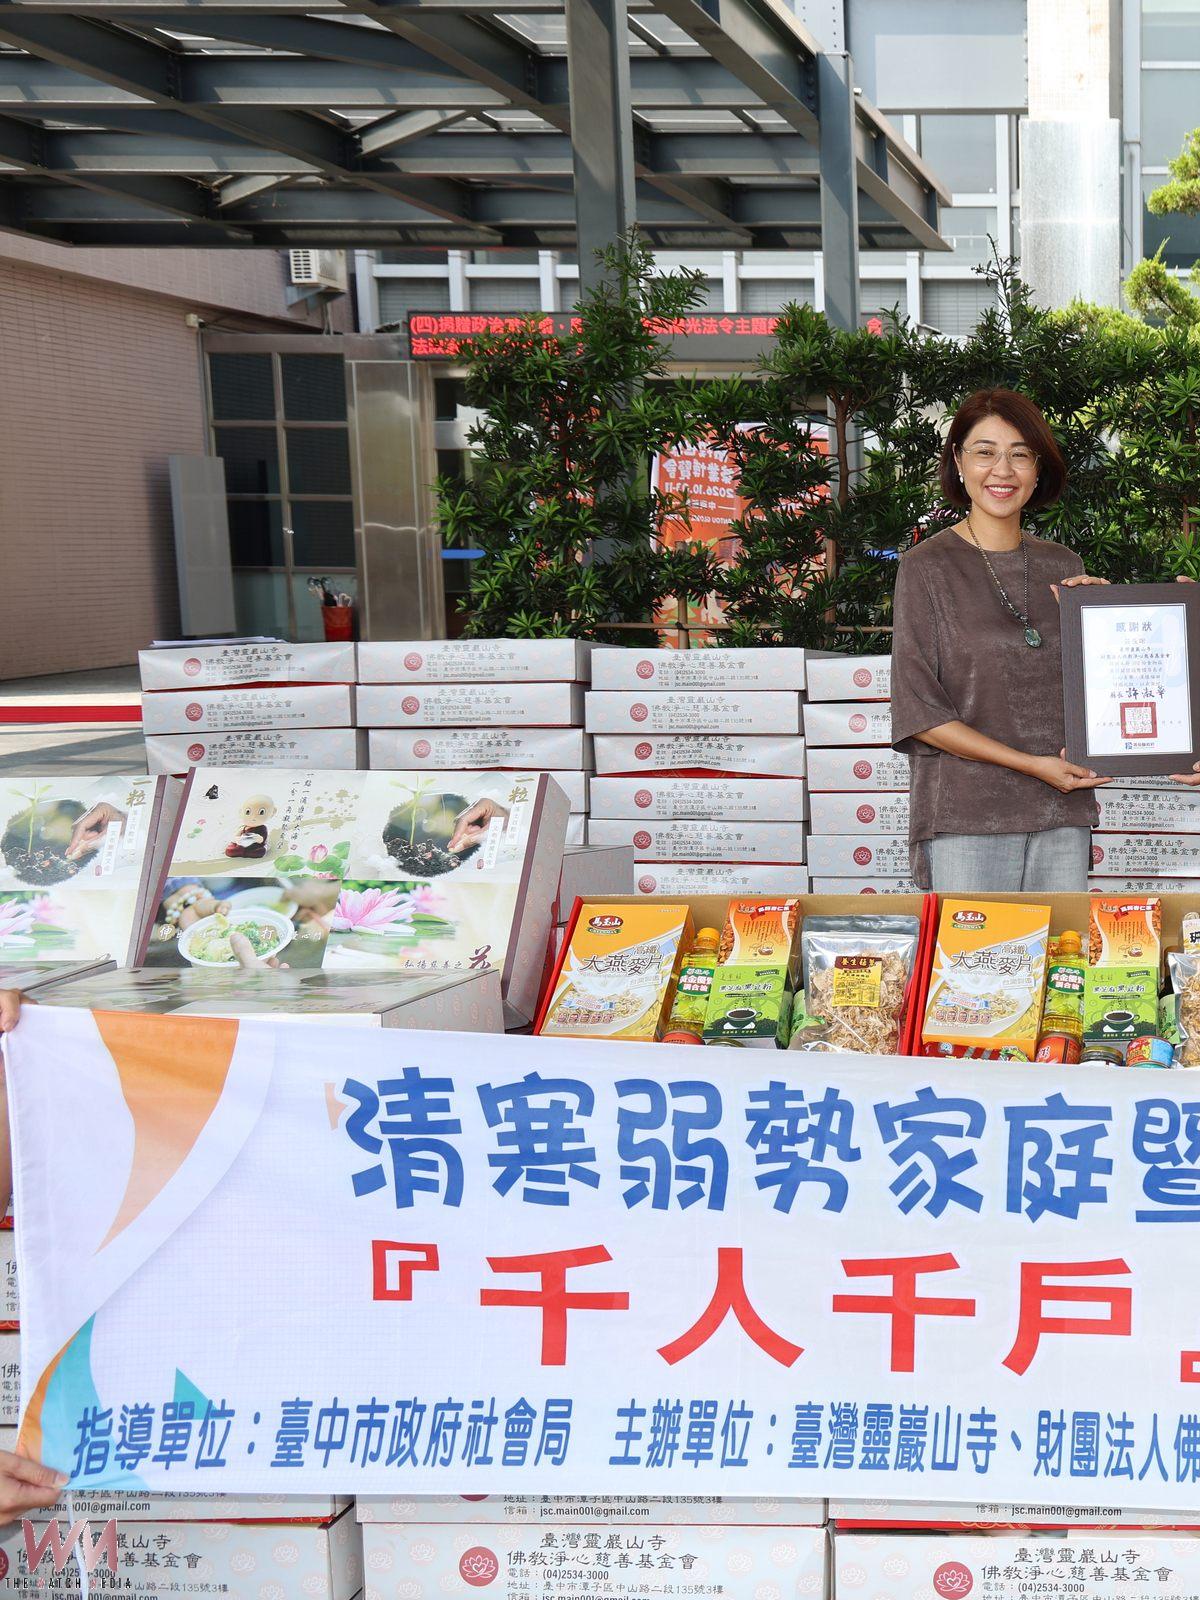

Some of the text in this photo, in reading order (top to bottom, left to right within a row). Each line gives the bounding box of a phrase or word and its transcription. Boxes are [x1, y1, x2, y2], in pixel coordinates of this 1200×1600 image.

[592, 916, 621, 926] 馬玉山
[956, 912, 985, 922] 馬玉山
[579, 955, 662, 976] 大燕麥片
[951, 950, 1032, 975] 大燕麥片
[539, 1532, 667, 1551] 臺灣靈巖山寺
[507, 1551, 699, 1570] 佛教淨心慈善基金會
[1014, 1547, 1141, 1564] 臺灣靈巖山寺
[981, 1565, 1173, 1582] 佛教淨心慈善基金會
